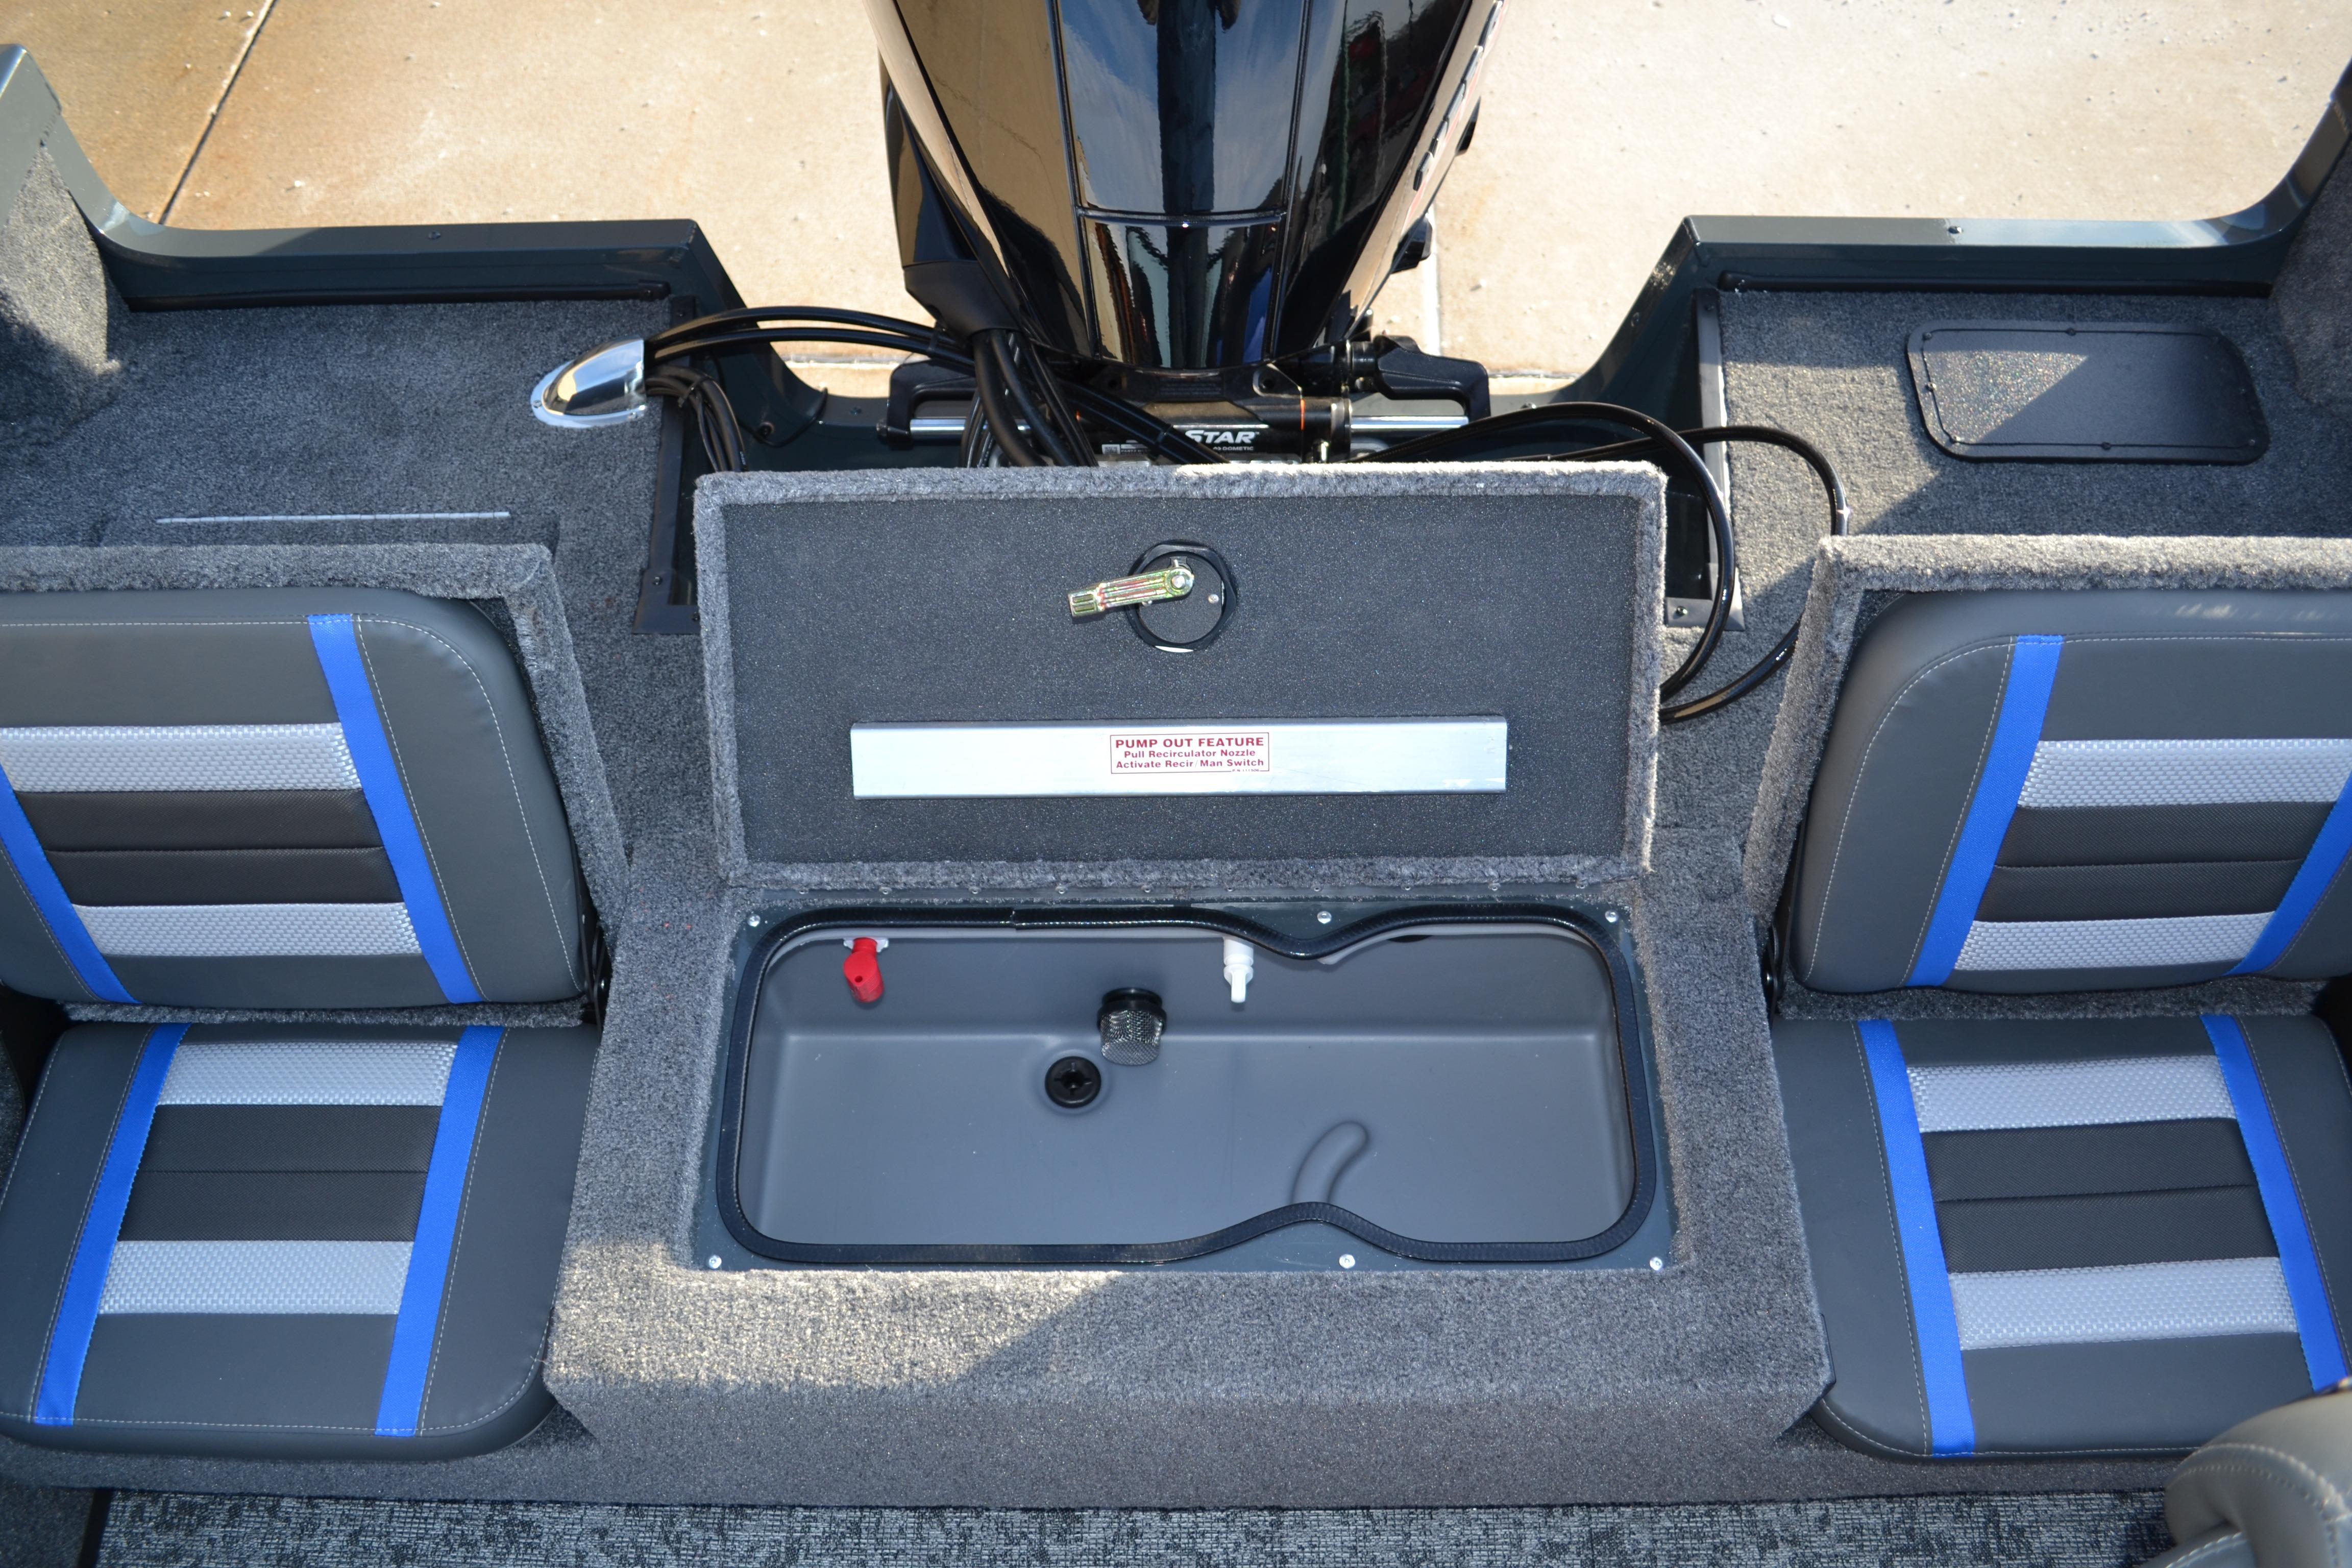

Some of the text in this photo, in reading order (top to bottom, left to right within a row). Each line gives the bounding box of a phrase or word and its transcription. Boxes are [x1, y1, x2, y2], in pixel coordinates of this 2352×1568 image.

[1116, 738, 1264, 748] PUMP OUT FEATURE
